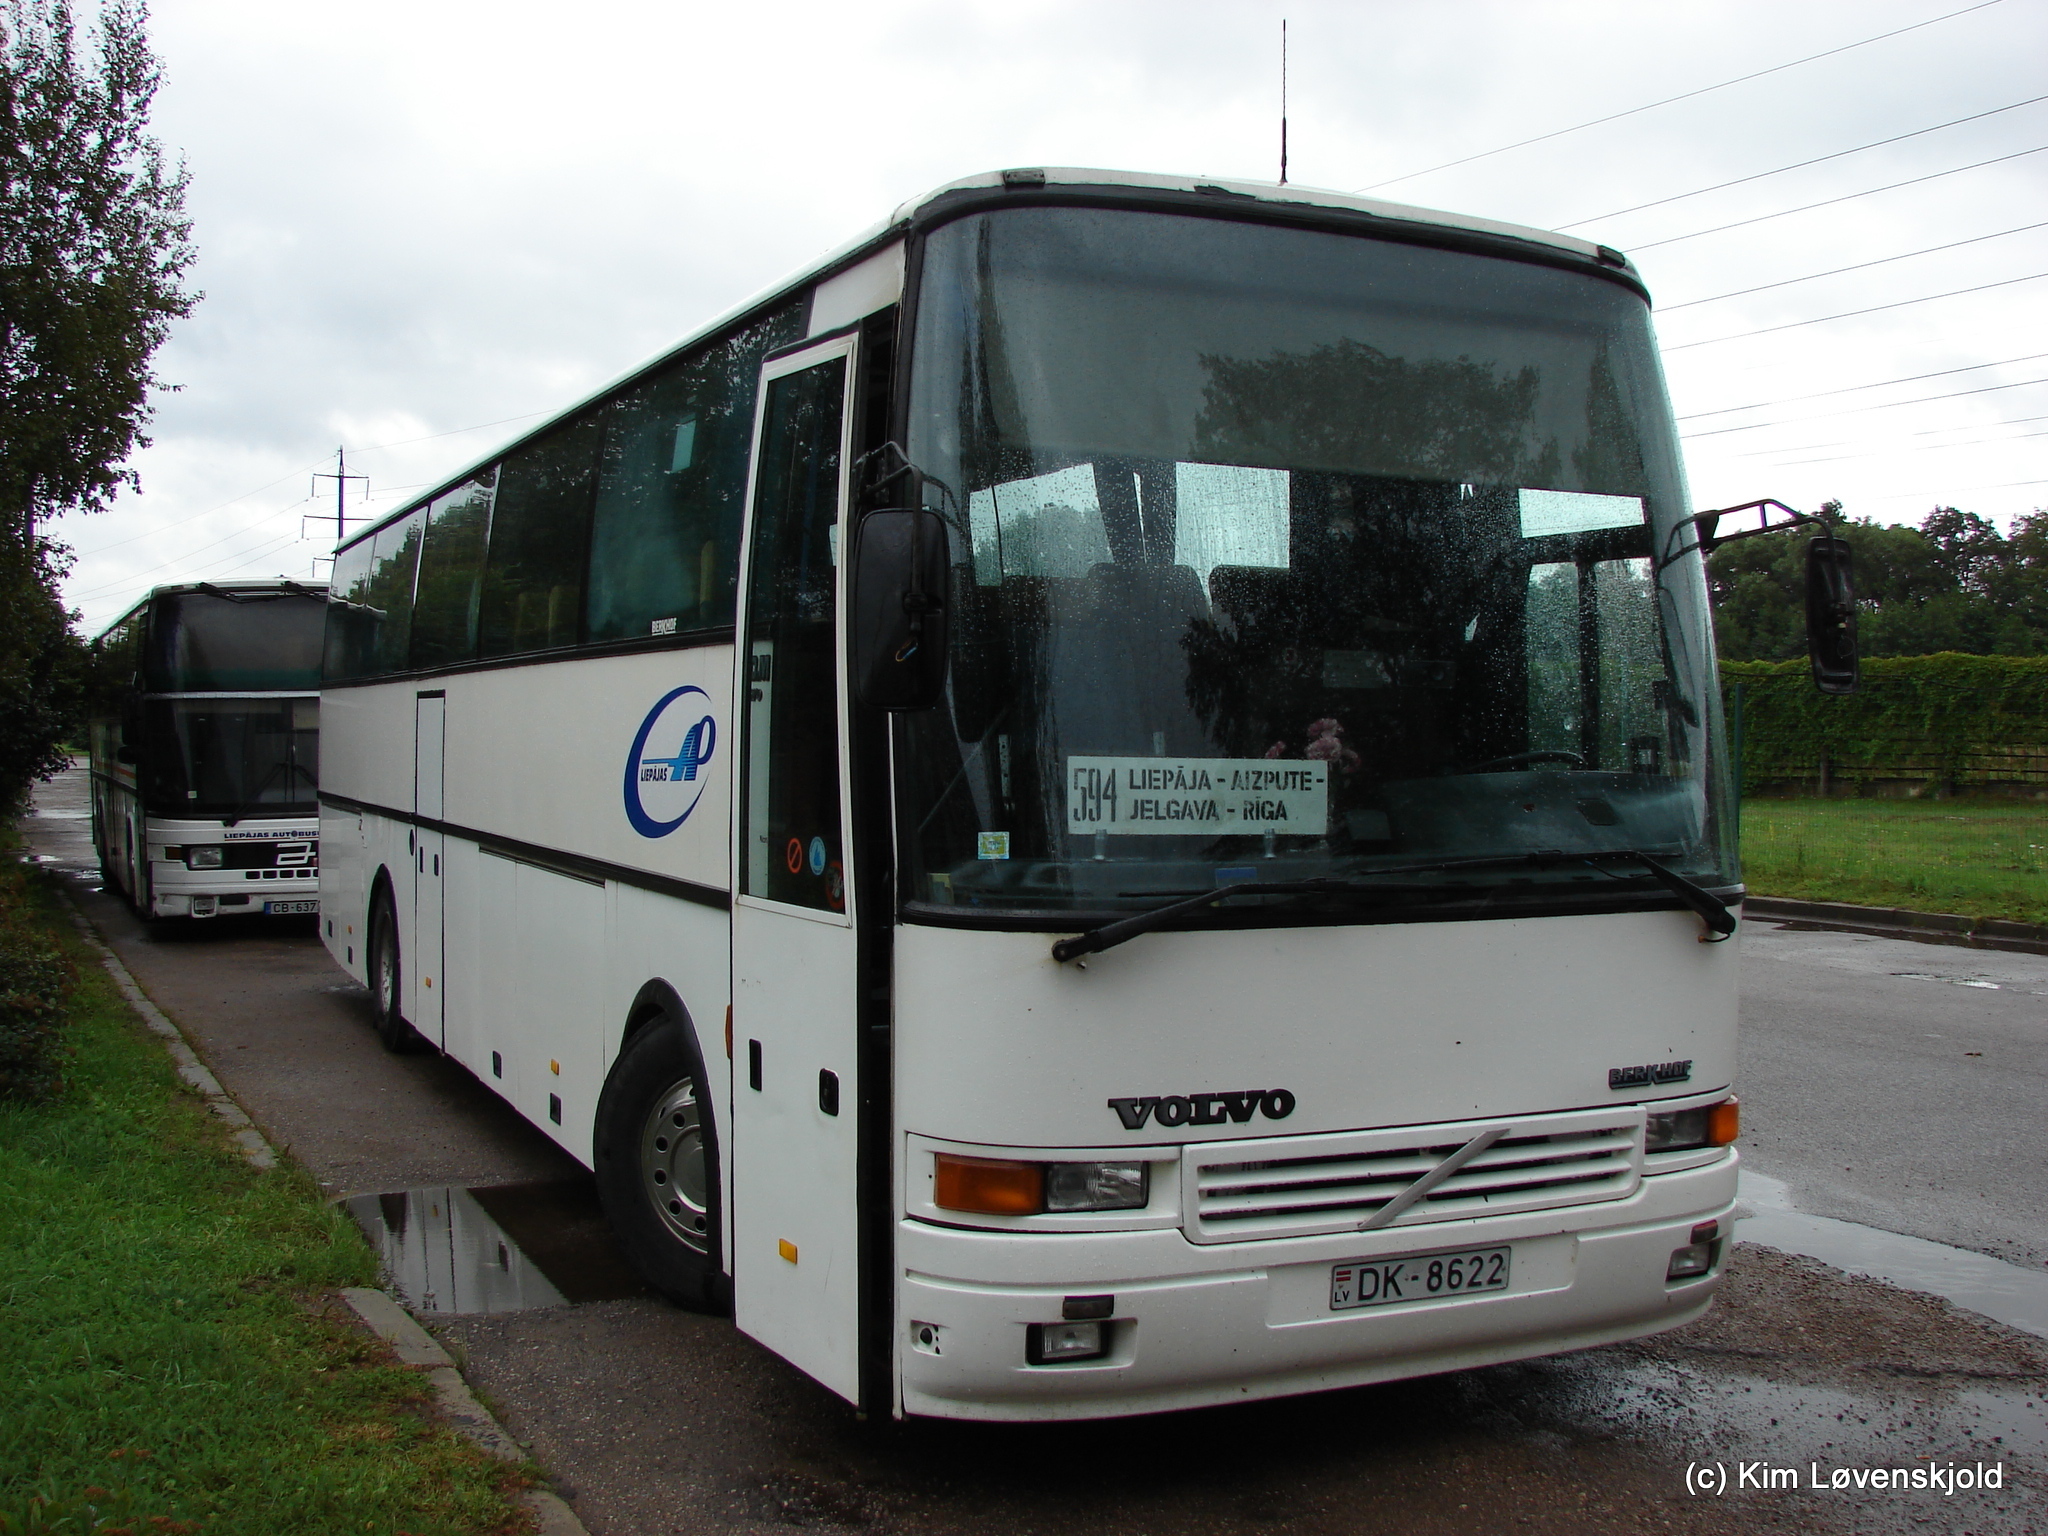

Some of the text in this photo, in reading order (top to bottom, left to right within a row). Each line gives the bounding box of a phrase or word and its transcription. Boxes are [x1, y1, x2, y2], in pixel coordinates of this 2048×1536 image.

[1129, 766, 1212, 790] LIEPĀJA
[1073, 768, 1117, 822] 594
[1130, 799, 1220, 821] JELGAVA
[1243, 796, 1288, 821] RĪGA
[1609, 1060, 1692, 1089] BERKHOF
[1108, 1088, 1296, 1130] VOLVO
[1334, 1290, 1350, 1303] LV
